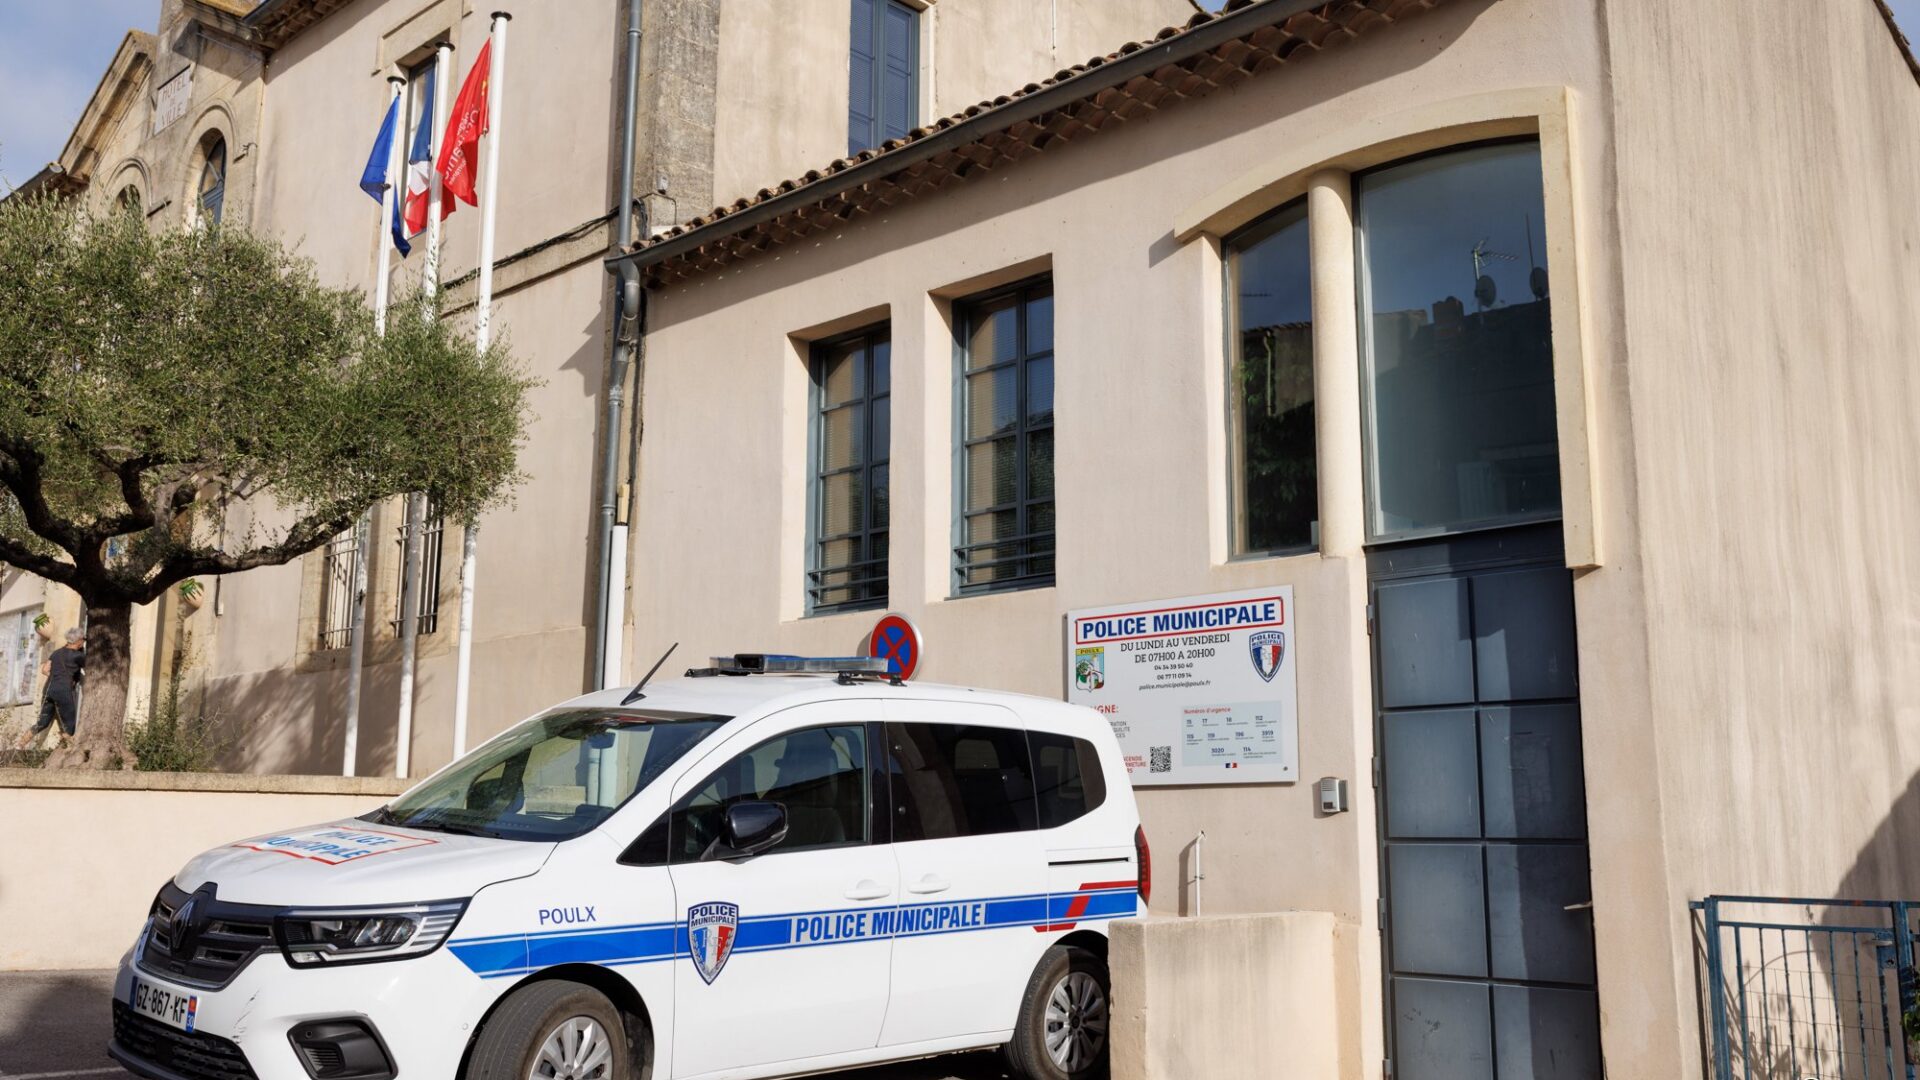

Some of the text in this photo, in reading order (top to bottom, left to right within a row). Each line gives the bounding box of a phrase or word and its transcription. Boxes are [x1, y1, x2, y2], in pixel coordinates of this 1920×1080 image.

[1083, 603, 1275, 639] POLICE MUNICIPALE
[1120, 633, 1231, 652] DU LUNDI AU VENDREDI
[1134, 648, 1215, 663] DE 07H00 A 20H00
[314, 831, 398, 846] POLICE
[538, 905, 597, 926] POULX
[690, 915, 735, 927] MUNICIPALE
[691, 905, 736, 920] POLICE
[795, 904, 982, 943] POLICE MUNICIPALE
